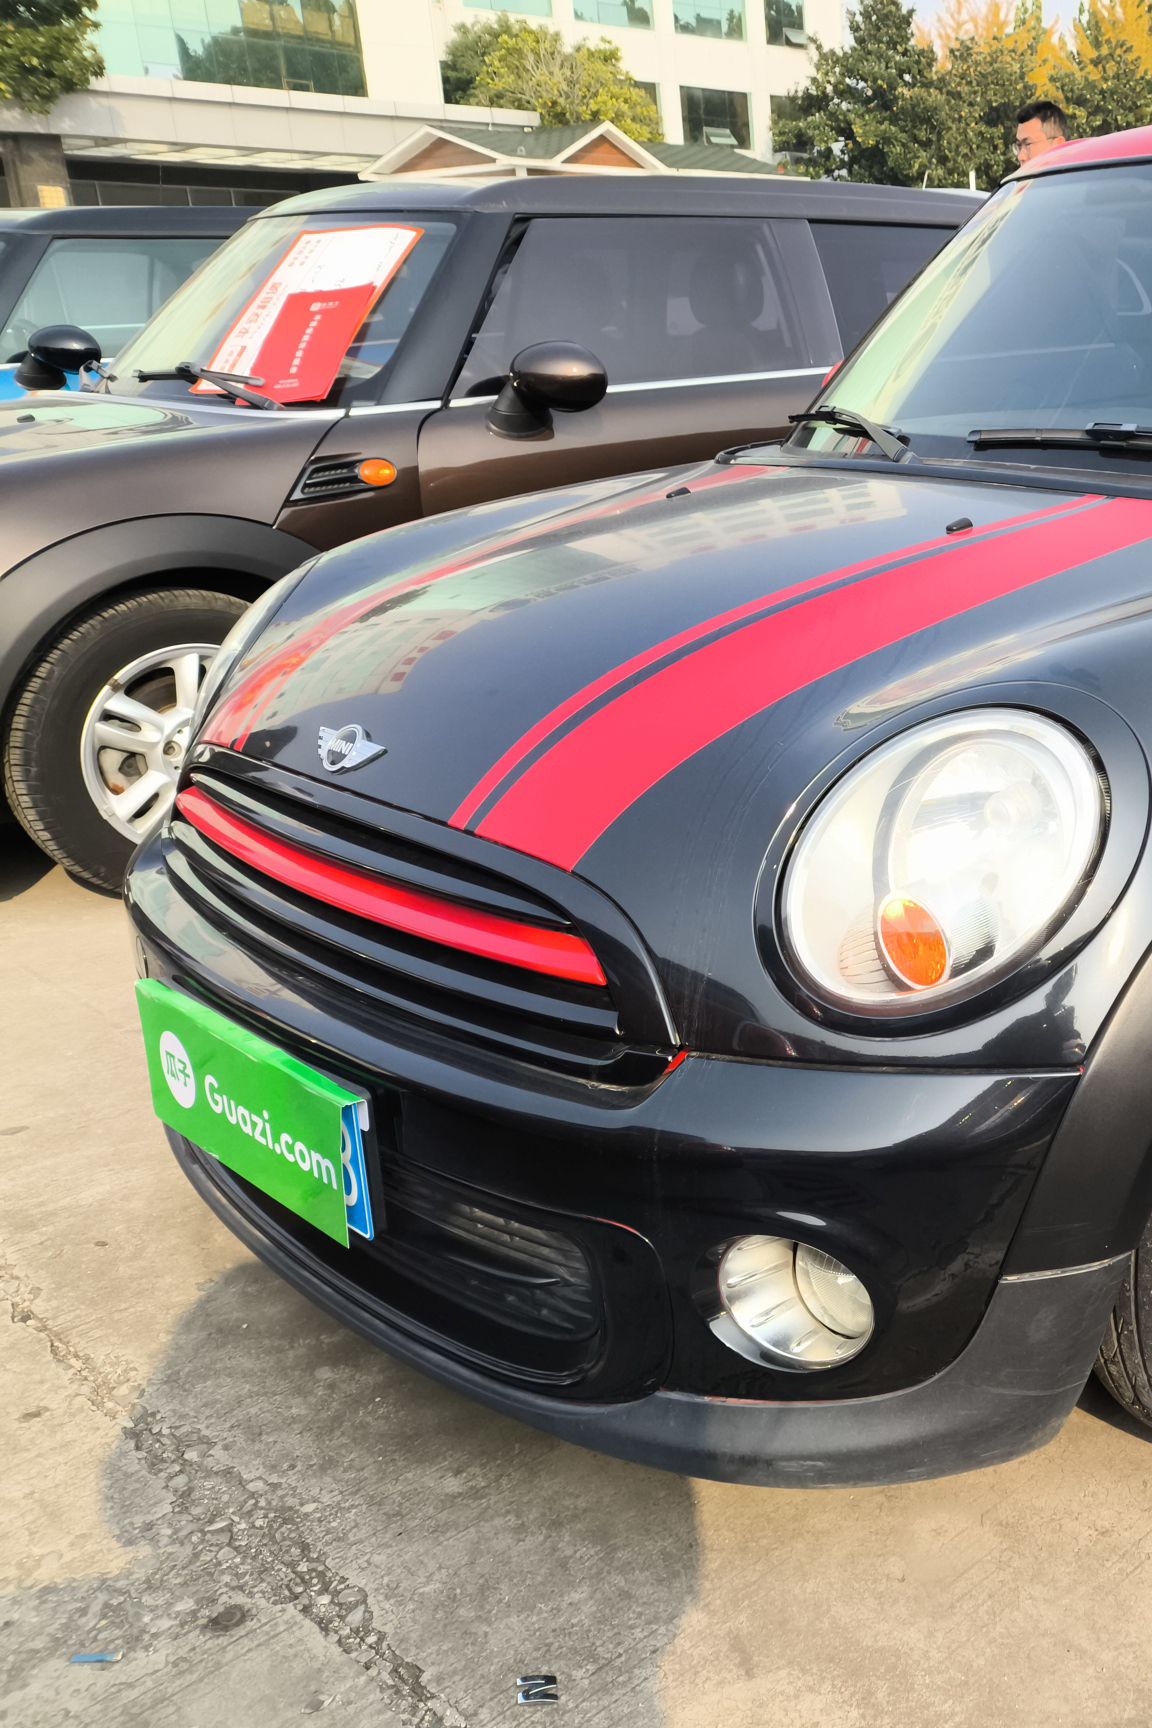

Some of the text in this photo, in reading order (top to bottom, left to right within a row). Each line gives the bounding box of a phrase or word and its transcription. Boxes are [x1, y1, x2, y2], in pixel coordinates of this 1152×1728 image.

[330, 738, 354, 755] MINI
[165, 1050, 190, 1087] 瓜子
[204, 1075, 338, 1190] Guazi.com
